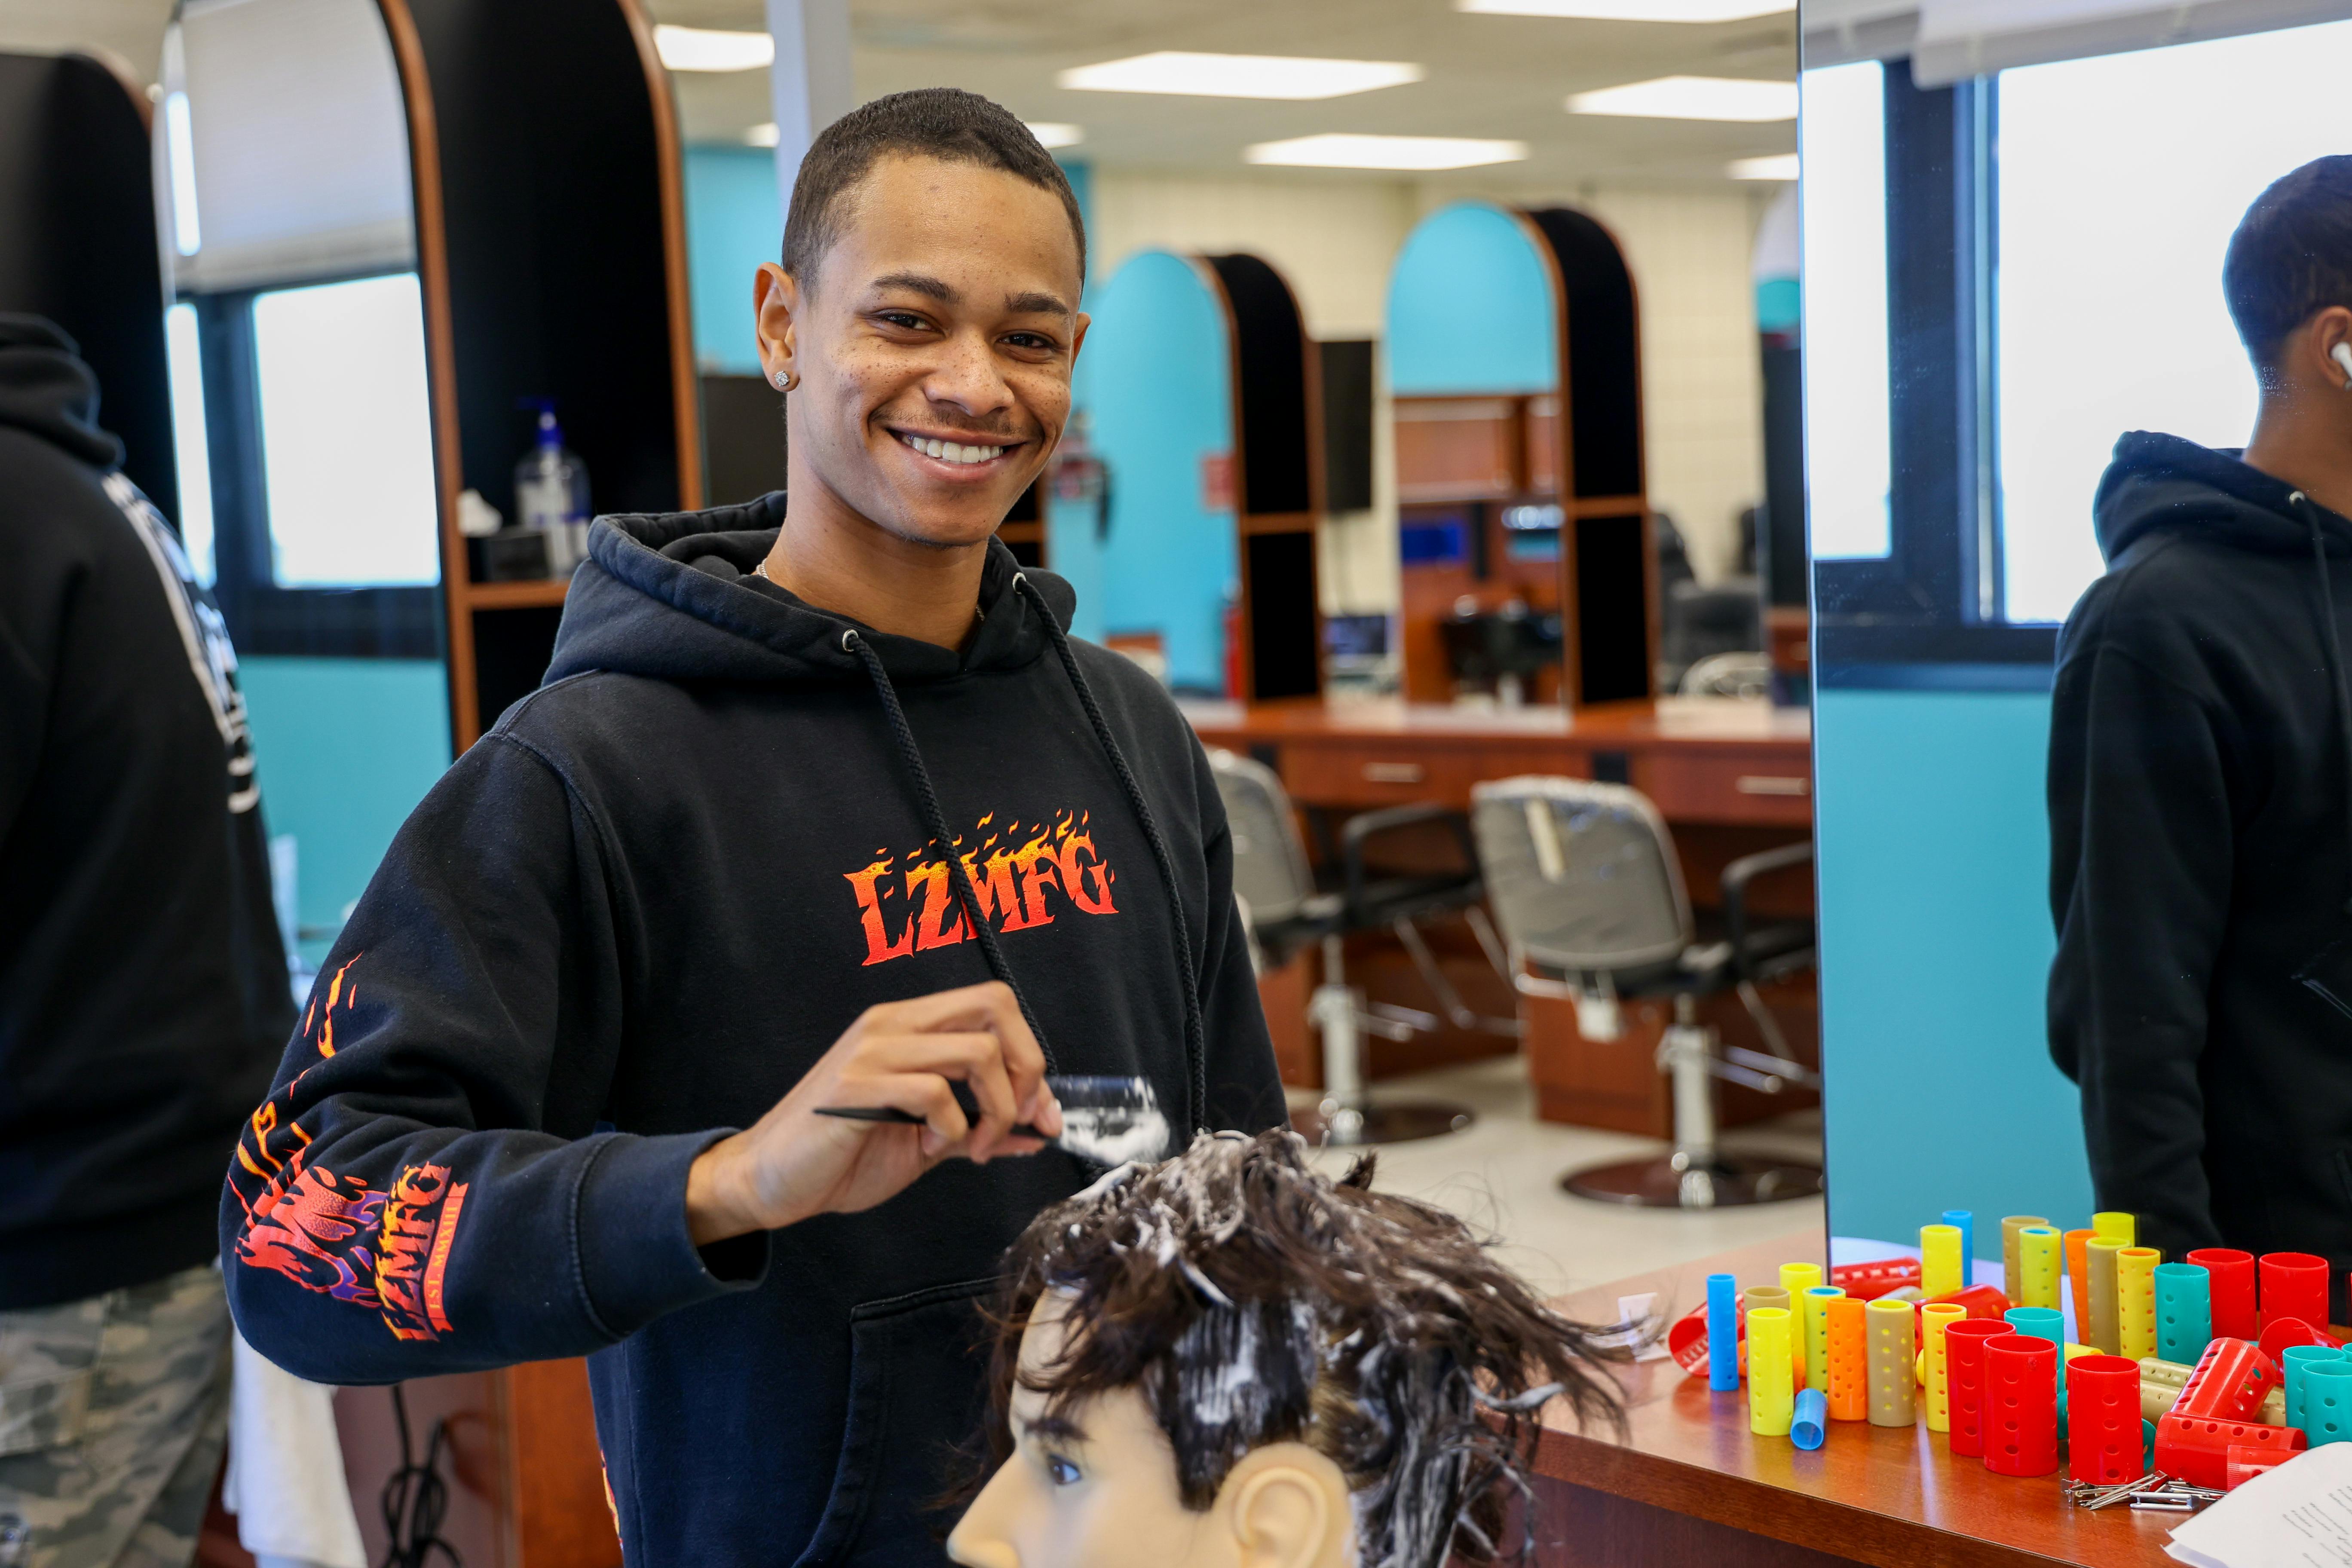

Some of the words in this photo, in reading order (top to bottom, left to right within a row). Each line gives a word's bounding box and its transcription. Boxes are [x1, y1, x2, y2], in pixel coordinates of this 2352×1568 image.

[843, 823, 1118, 966] LZMFG
[432, 1207, 457, 1266] MMXIII
[428, 1273, 441, 1309] EST.
